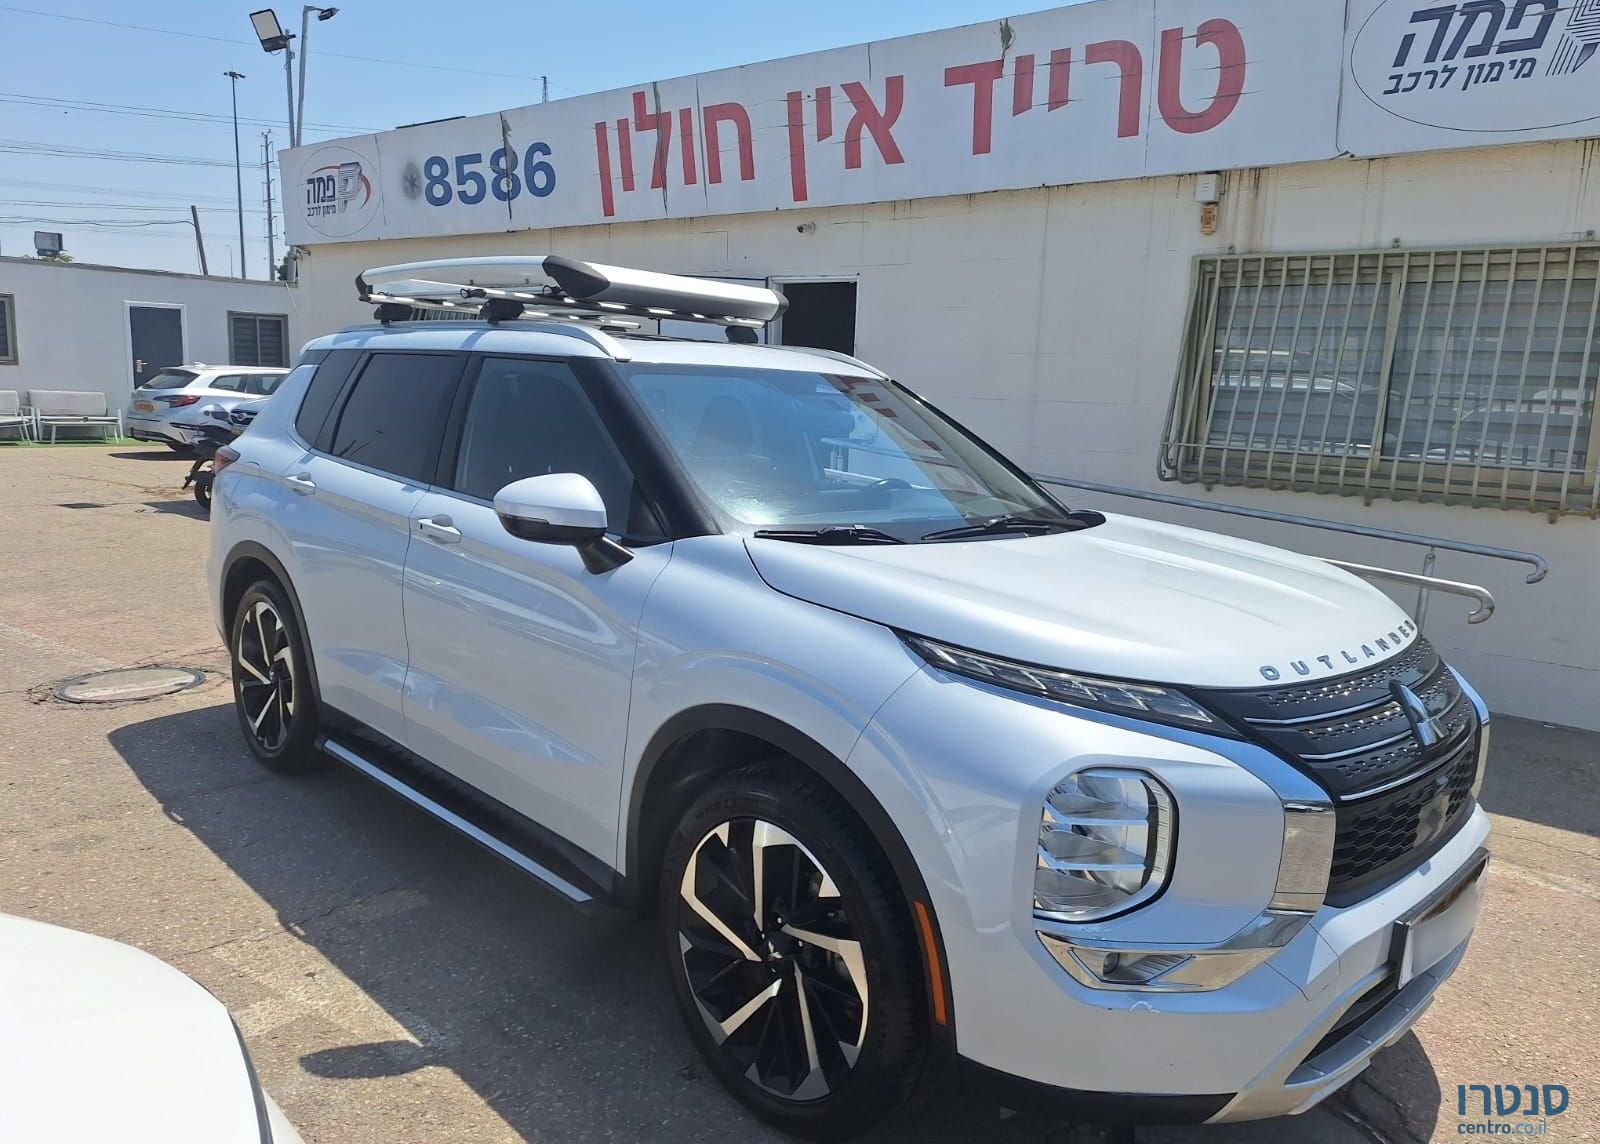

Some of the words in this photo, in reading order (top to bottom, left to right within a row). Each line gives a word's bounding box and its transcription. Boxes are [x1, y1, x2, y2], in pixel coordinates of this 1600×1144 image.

[1392, 0, 1559, 68] פמה
[943, 18, 1247, 155] טרייד
[1382, 64, 1458, 95] לרכב
[1461, 57, 1537, 91] מימון
[594, 91, 755, 217] חולון
[787, 75, 905, 202] אין
[306, 174, 336, 205] פמה
[1258, 619, 1416, 681] OUTLANDER
